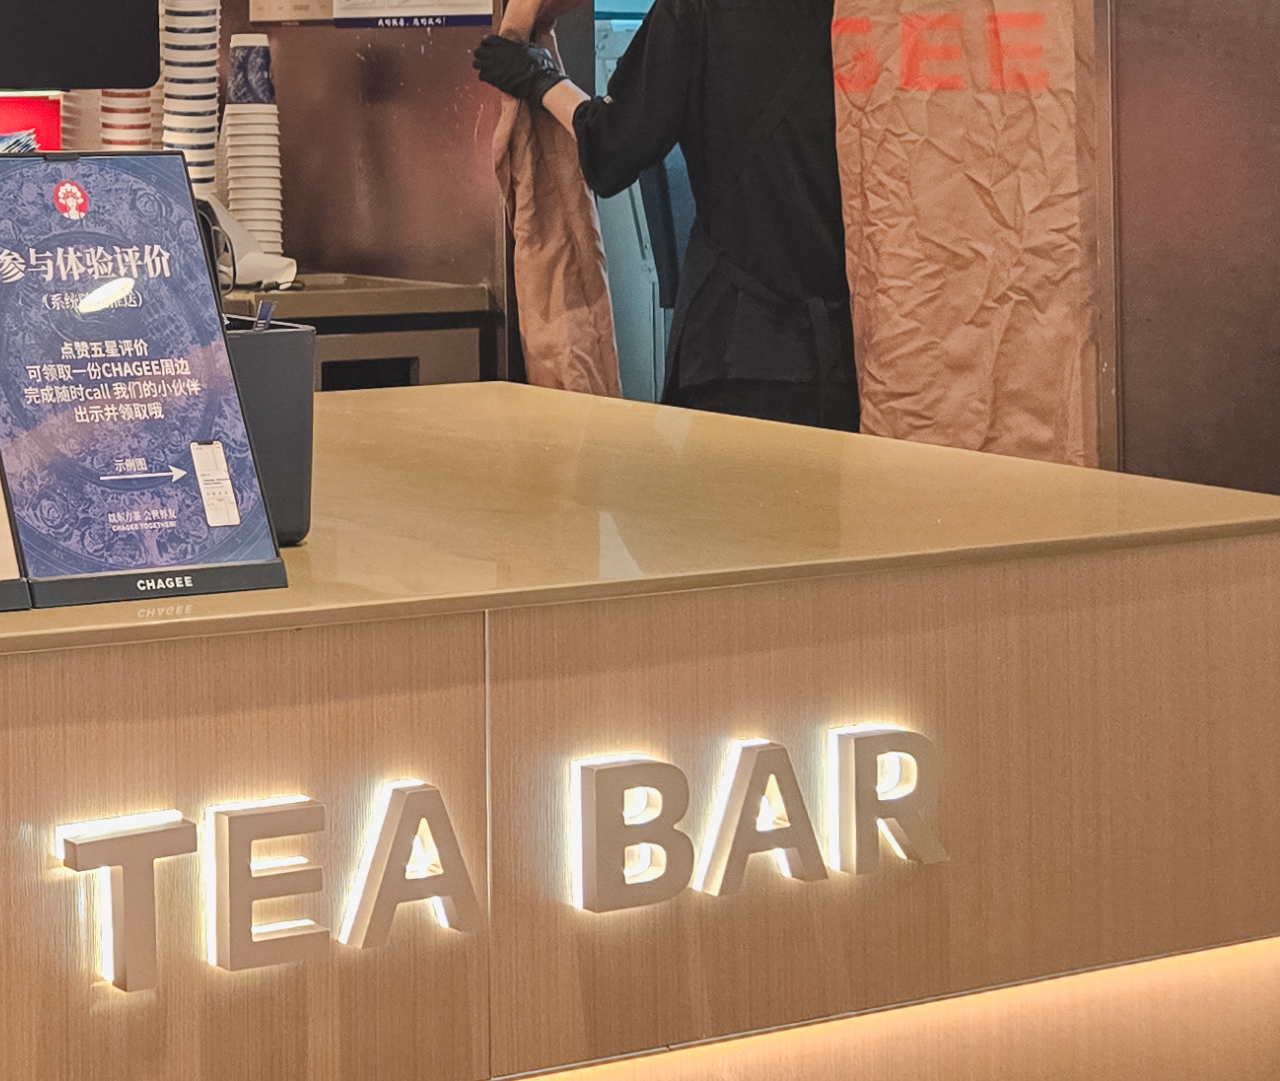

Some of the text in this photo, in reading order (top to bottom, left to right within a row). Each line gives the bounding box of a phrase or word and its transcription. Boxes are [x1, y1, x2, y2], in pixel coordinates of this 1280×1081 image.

[60, 338, 149, 360] 点赞五星评价
[25, 357, 191, 383] 可领取一份CHAGEE周边
[23, 378, 202, 405] 完成随时call 我们的小伙伴
[74, 401, 165, 425] 出示并领取哦
[113, 457, 148, 472] 示例图
[136, 575, 194, 591] CHAGEE
[54, 723, 950, 992] TEA BAR
